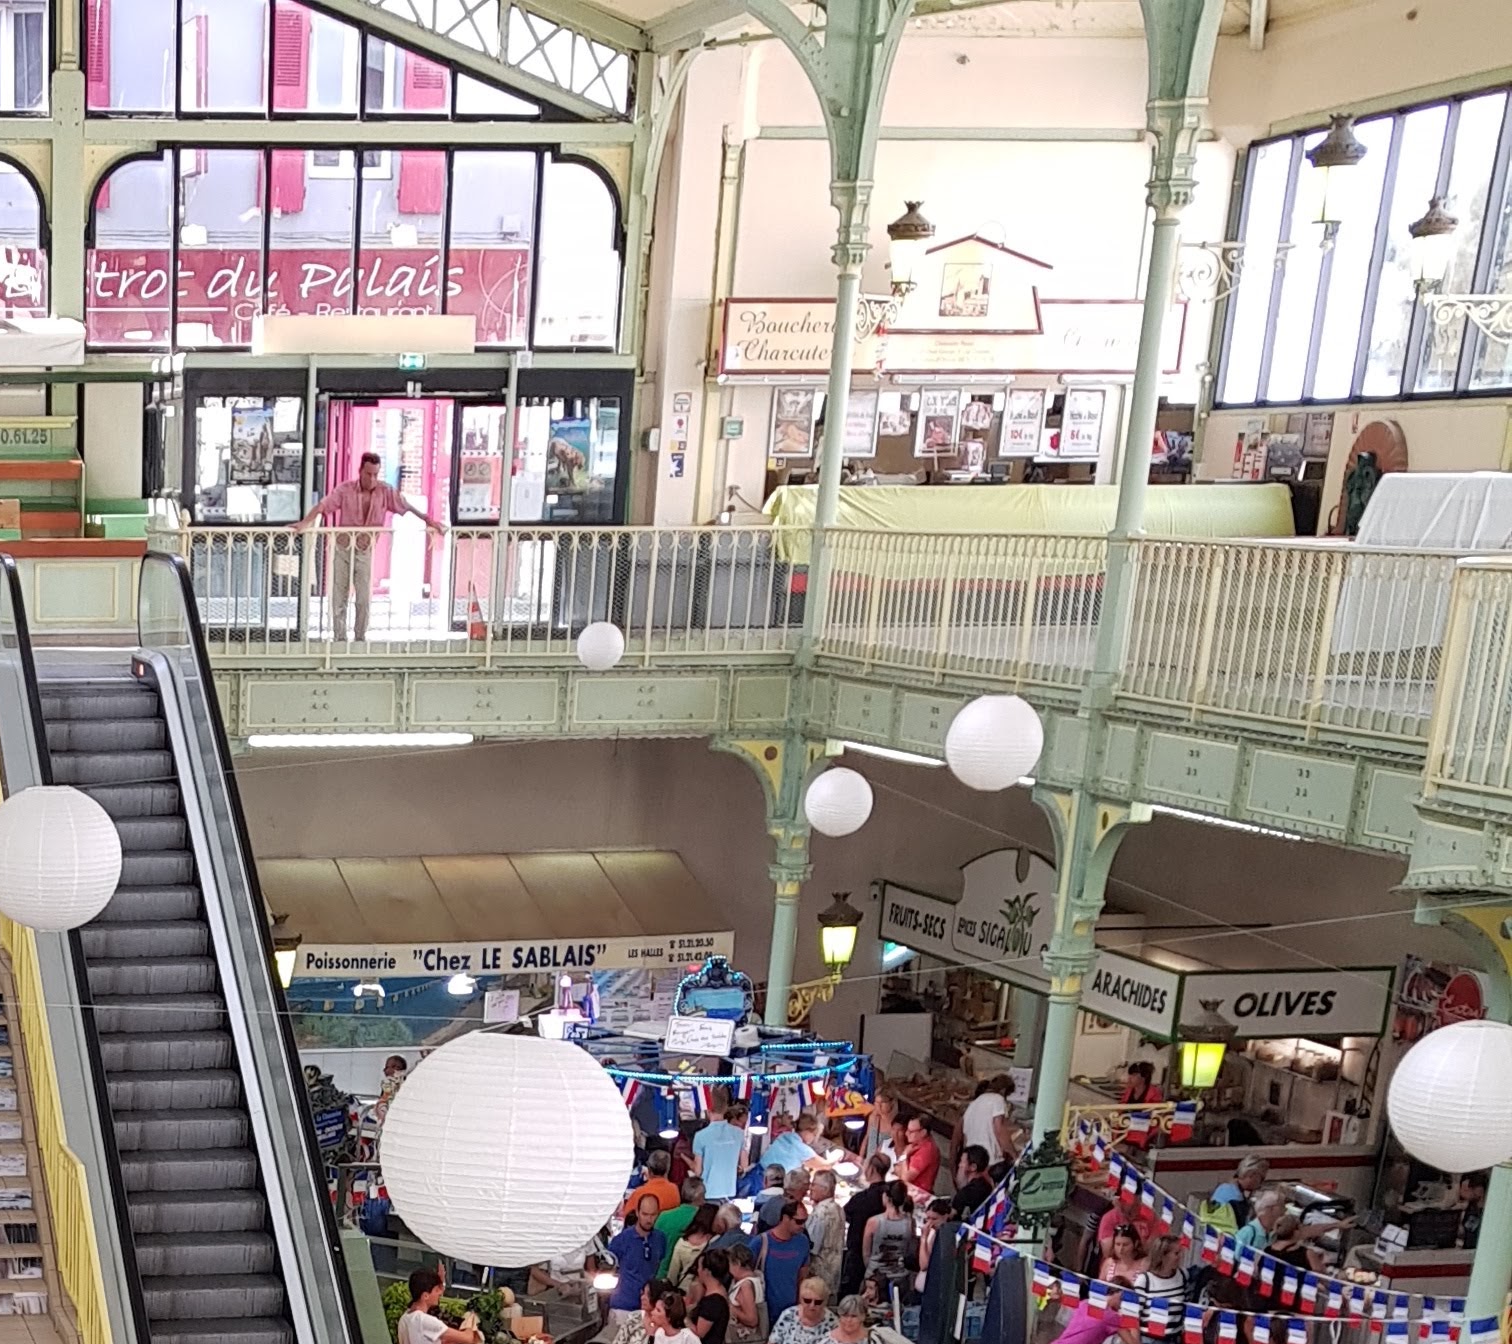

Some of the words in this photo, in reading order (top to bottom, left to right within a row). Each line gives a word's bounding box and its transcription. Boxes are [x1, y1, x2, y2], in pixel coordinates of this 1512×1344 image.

[94, 264, 196, 299] trot
[208, 257, 278, 299] du
[300, 255, 463, 299] Palais
[740, 311, 836, 334] Boucheri
[737, 338, 829, 361] Charcute
[888, 903, 947, 940] FRUITS-SECS
[305, 952, 397, 970] Poissonnerie
[482, 949, 502, 970] LE
[628, 948, 639, 958] LES
[640, 947, 664, 958] HALLES
[1092, 969, 1168, 1014] ARACHIDES
[1233, 990, 1337, 1018] OLIVES
